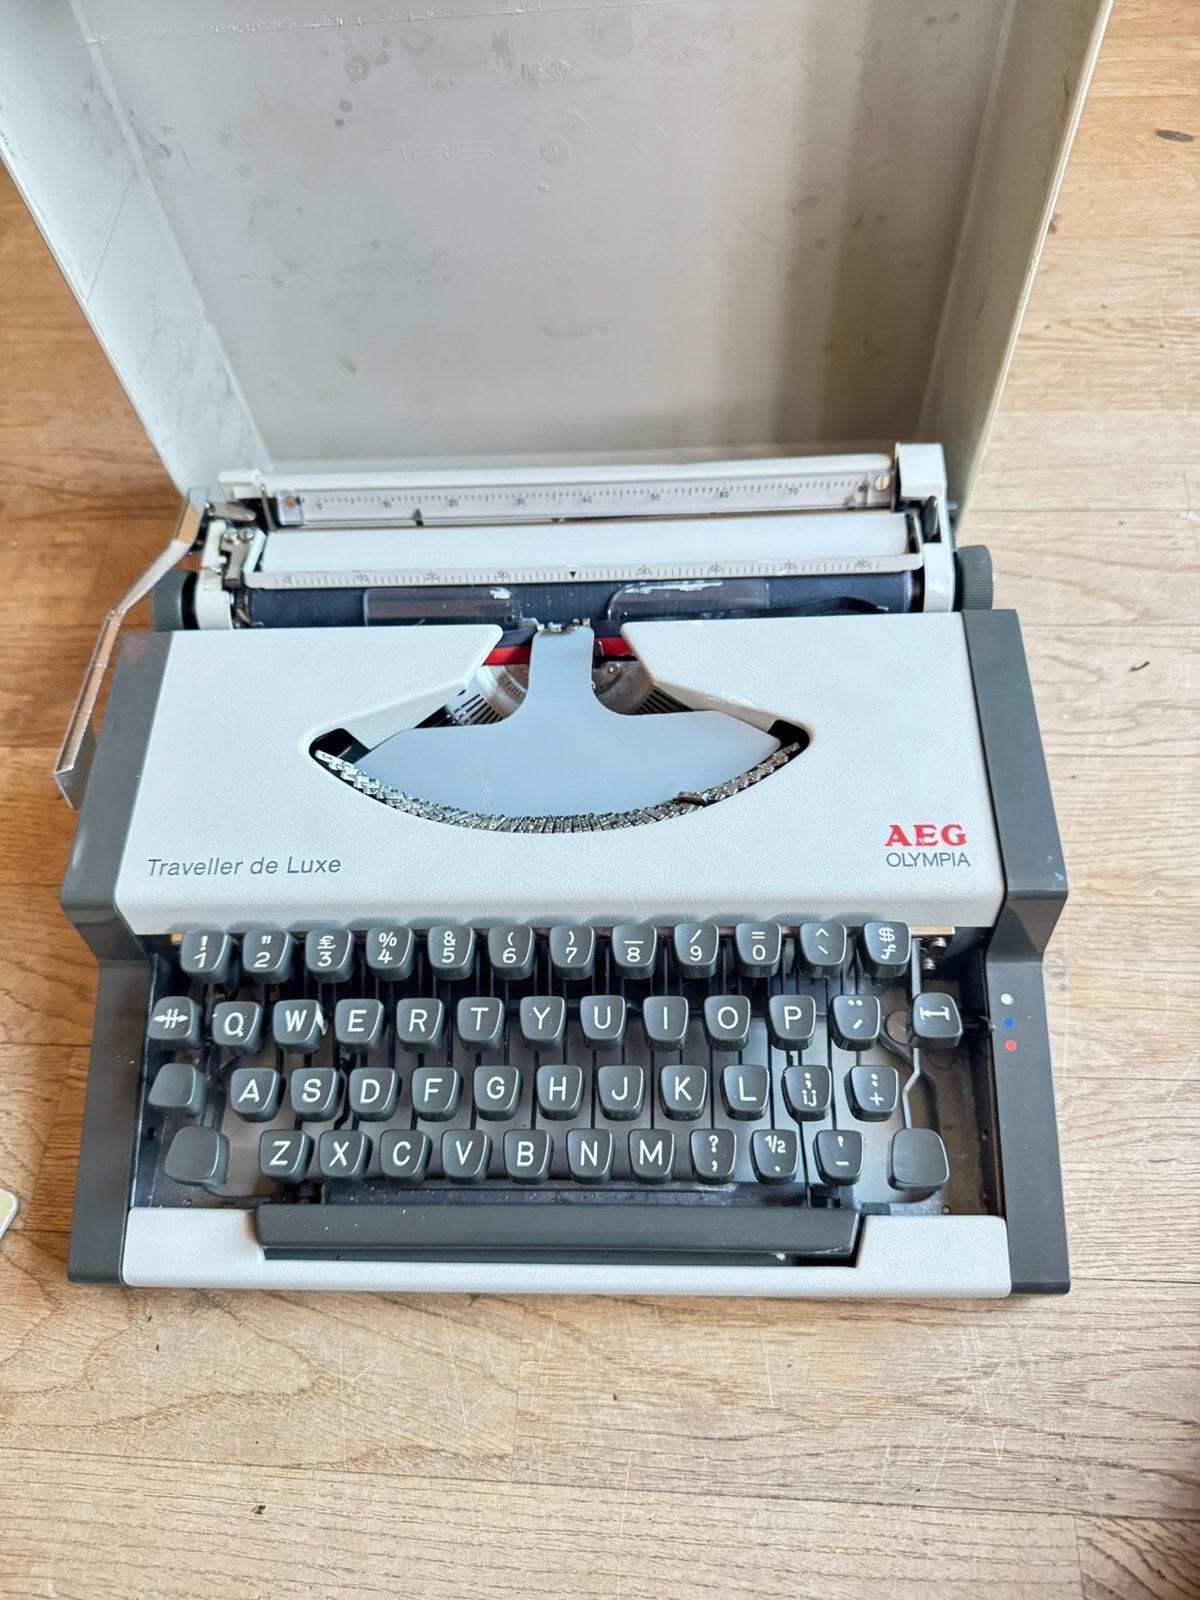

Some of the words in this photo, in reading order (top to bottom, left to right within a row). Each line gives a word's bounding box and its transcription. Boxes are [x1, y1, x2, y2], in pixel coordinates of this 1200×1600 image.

[884, 823, 967, 847] AEG
[147, 857, 244, 876] Traveller
[250, 856, 278, 875] de
[286, 856, 341, 874] Luxe
[886, 851, 971, 868] OLYMPIA
[378, 931, 398, 948] %
[443, 930, 456, 947] &
[507, 931, 514, 946] (
[567, 930, 575, 946] )
[877, 926, 896, 943] $
[193, 951, 207, 968] 1
[253, 951, 271, 968] 2
[317, 951, 332, 967] 3
[377, 948, 393, 964] 4
[441, 947, 455, 964] 5
[502, 947, 517, 964] 6
[565, 946, 578, 964] 7
[626, 946, 641, 963] 8
[689, 945, 703, 962] 9
[752, 944, 767, 961] 0
[223, 1011, 244, 1037] Q
[285, 1009, 308, 1033] W
[347, 1009, 367, 1033] E
[408, 1008, 428, 1033] R
[470, 1006, 490, 1031] T
[533, 1006, 551, 1030] Y
[592, 1005, 612, 1030] U
[662, 1005, 669, 1031] I
[716, 1005, 740, 1030] O
[783, 1005, 803, 1030] P
[238, 1078, 261, 1104] A
[301, 1078, 322, 1103] S
[359, 1078, 381, 1104] D
[423, 1077, 443, 1103] F
[486, 1075, 505, 1100] G
[547, 1076, 567, 1102] H
[610, 1076, 629, 1102] J
[673, 1075, 693, 1102] K
[738, 1075, 758, 1102] L
[269, 1140, 292, 1166] Z
[329, 1141, 350, 1167] X
[391, 1140, 411, 1166] C
[455, 1140, 473, 1166] V
[516, 1140, 535, 1167] B
[579, 1140, 599, 1168] N
[638, 1140, 664, 1167] M
[708, 1134, 719, 1153] ?
